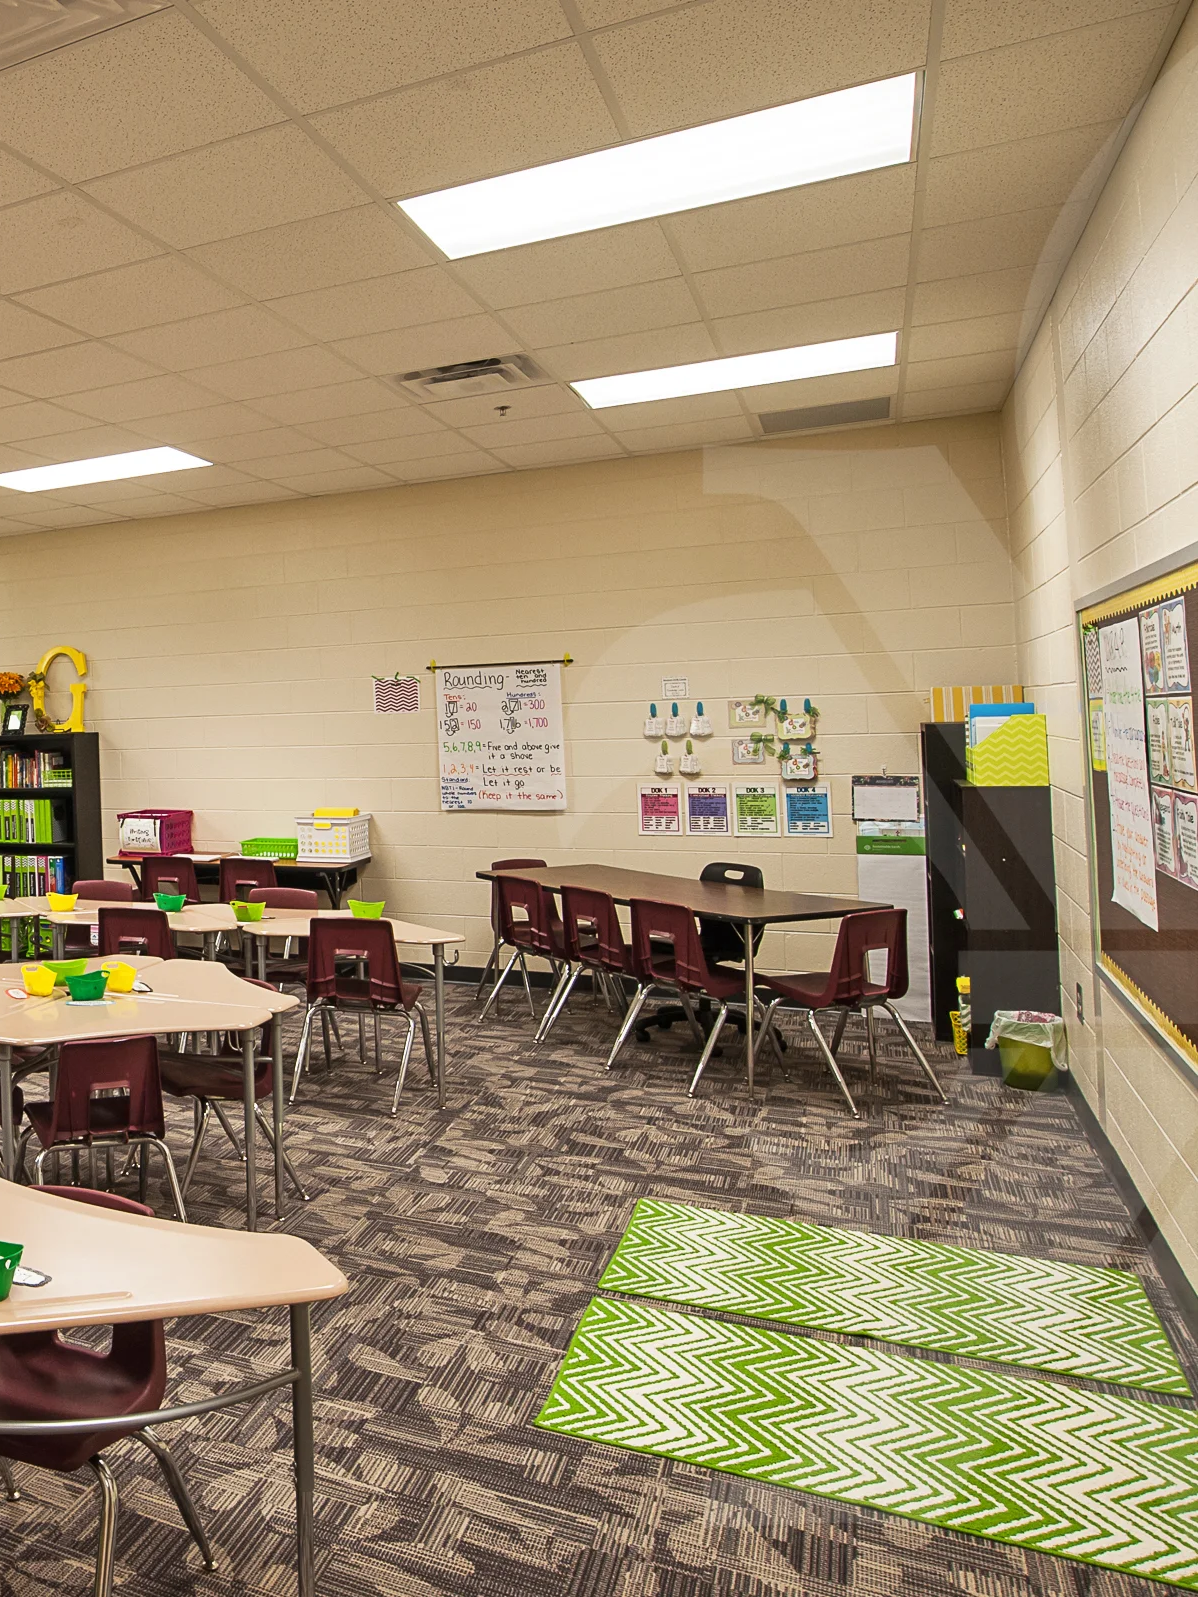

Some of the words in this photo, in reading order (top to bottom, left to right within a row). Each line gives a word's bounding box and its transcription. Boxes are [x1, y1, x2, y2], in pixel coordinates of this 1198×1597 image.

[443, 671, 504, 690] Rounding
[465, 701, 477, 712] 20
[529, 699, 545, 710] 300
[467, 718, 481, 730] 150
[528, 717, 548, 729] 1,700
[487, 741, 502, 751] Five
[504, 741, 518, 751] and
[521, 741, 543, 751] above
[544, 742, 560, 754] give
[488, 752, 496, 760] it
[510, 752, 533, 760] shove
[482, 763, 497, 774] Let
[502, 765, 509, 773] it
[514, 764, 533, 773] rest
[550, 764, 561, 773] be
[483, 777, 498, 787] Let
[515, 779, 525, 790] go
[505, 791, 513, 800] it
[517, 791, 532, 800] the
